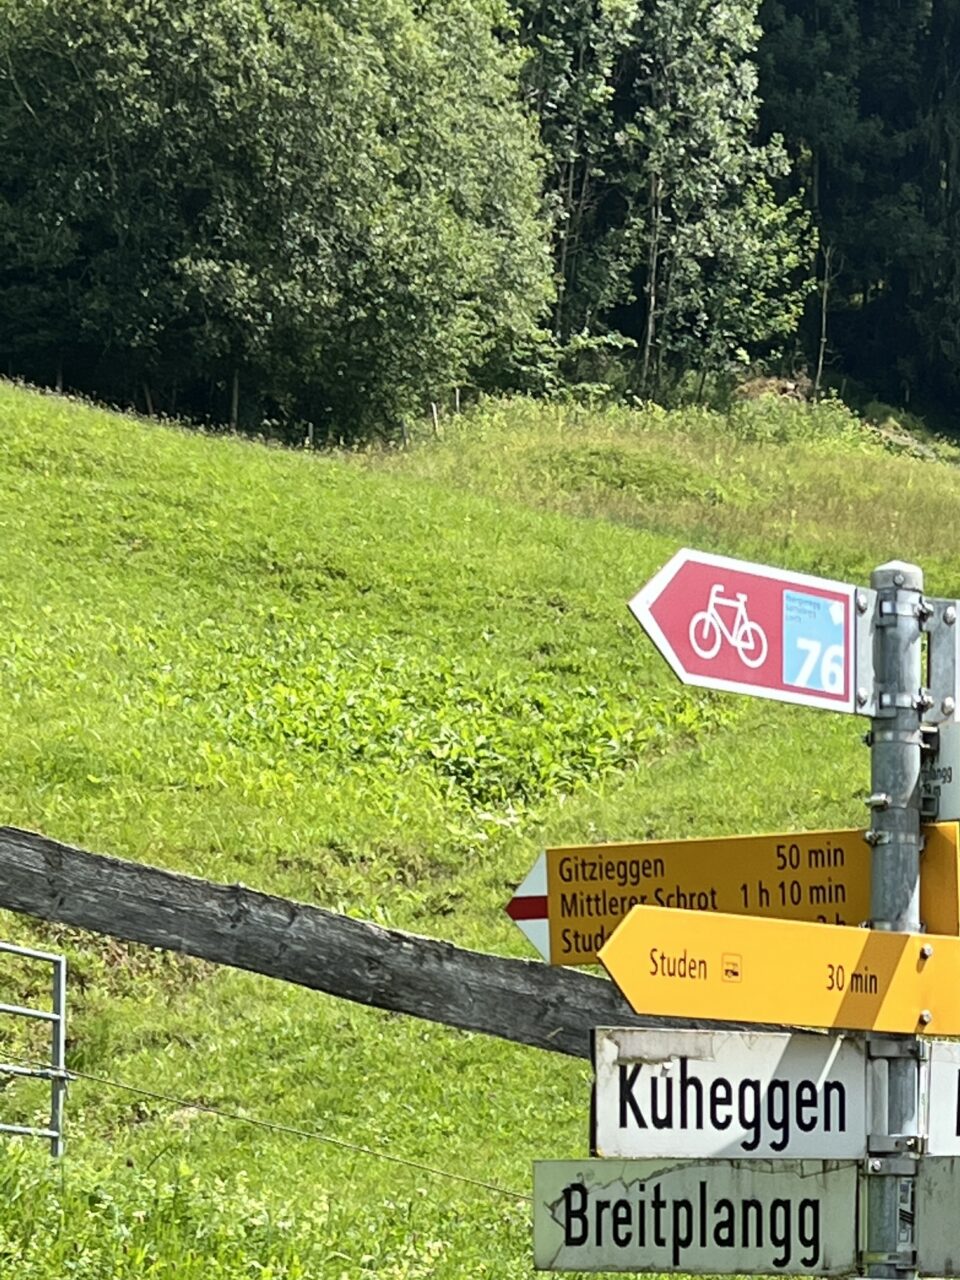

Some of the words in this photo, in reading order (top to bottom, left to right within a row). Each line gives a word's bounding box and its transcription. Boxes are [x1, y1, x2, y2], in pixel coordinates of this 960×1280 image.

[796, 637, 845, 695] 76
[559, 854, 665, 887] Gitzieggen
[776, 843, 800, 870] 50
[808, 841, 845, 868] min
[560, 889, 647, 918] Mittlerer
[654, 885, 718, 910] Schrot
[740, 883, 748, 908] 1
[758, 880, 770, 907] h
[779, 880, 801, 906] 10
[809, 876, 846, 905] min
[561, 925, 611, 953] Stud
[650, 948, 708, 981] Studen
[826, 964, 845, 991] 30
[850, 965, 878, 994] min
[562, 1181, 820, 1268] Breitplangg
